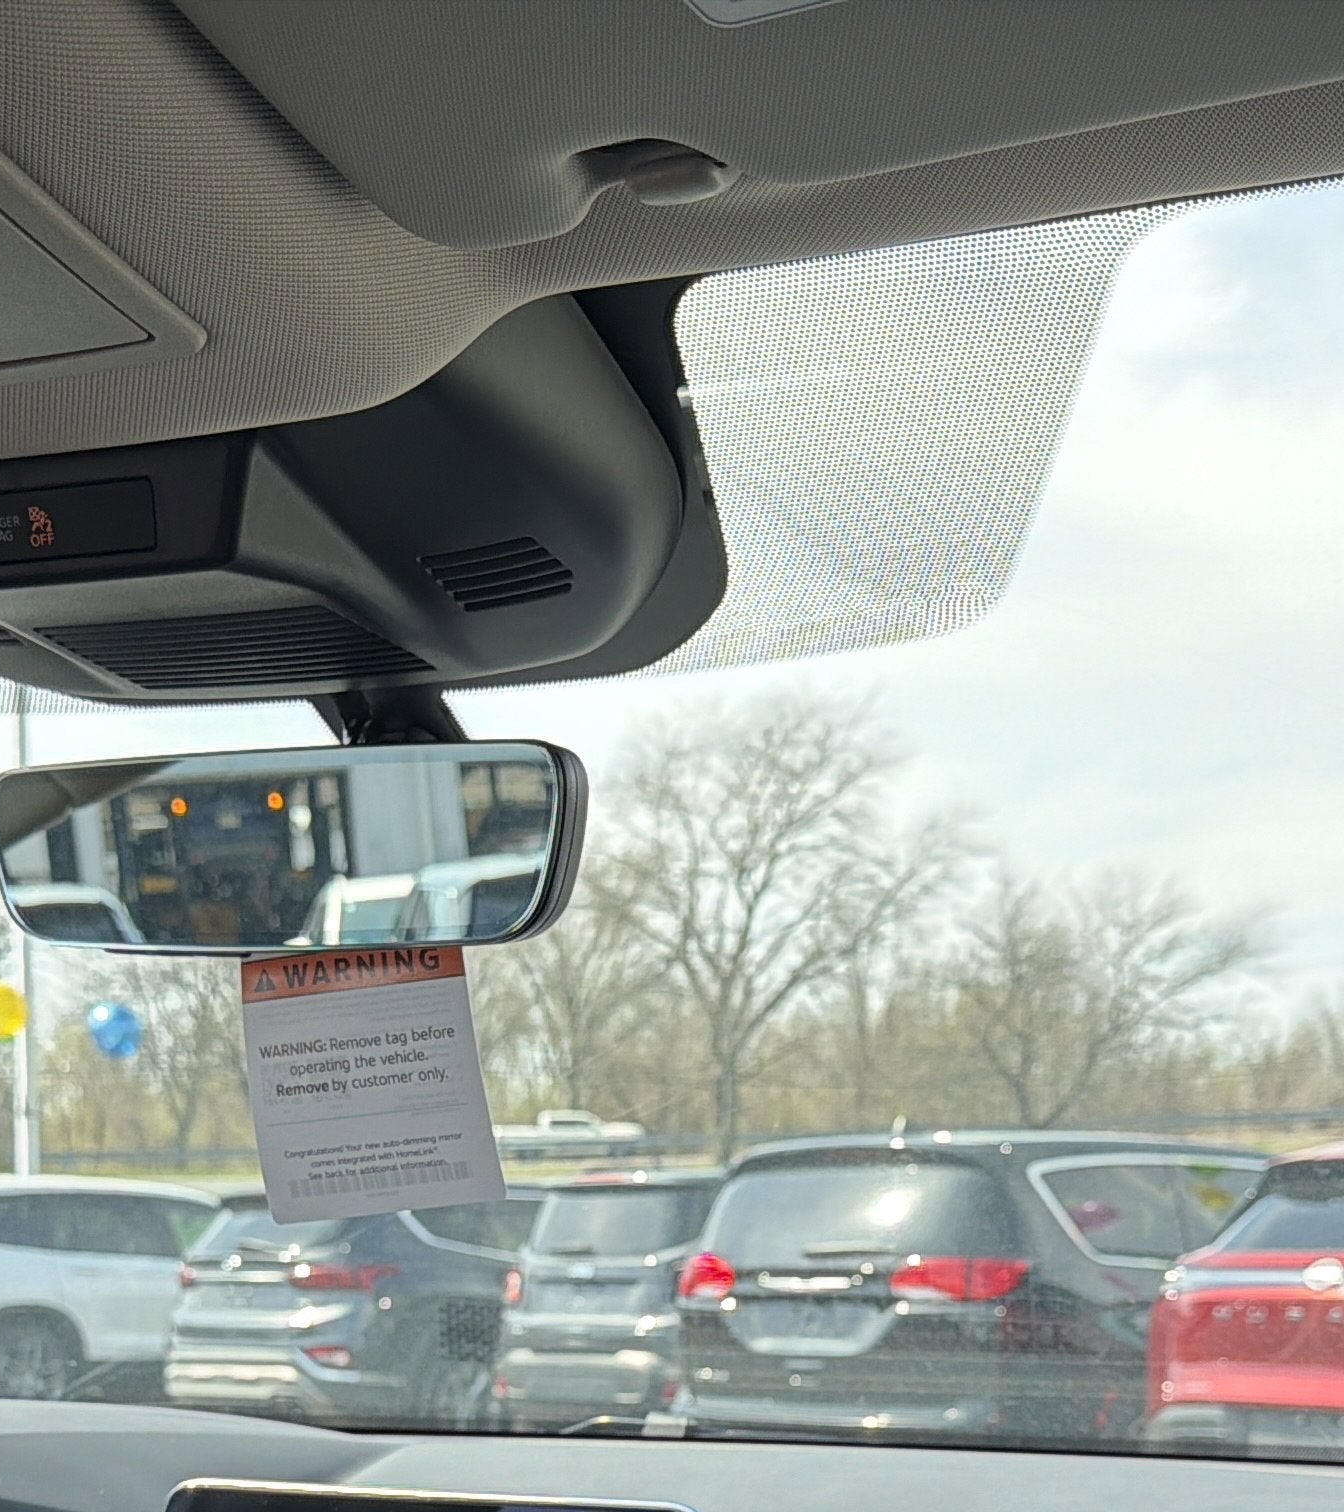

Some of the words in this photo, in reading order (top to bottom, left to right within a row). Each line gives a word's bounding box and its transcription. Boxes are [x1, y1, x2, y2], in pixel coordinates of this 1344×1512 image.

[30, 533, 55, 547] OFF
[283, 949, 440, 989] WARNING
[259, 1039, 327, 1059] WARNING:
[330, 1034, 381, 1051] Remove
[386, 1031, 407, 1045] tag
[412, 1026, 455, 1042] before
[290, 1058, 350, 1077] operating
[355, 1055, 376, 1068] the
[380, 1049, 428, 1065] vehicle.
[276, 1082, 329, 1097] Remove
[332, 1079, 347, 1093] by
[352, 1072, 413, 1090] customer
[418, 1067, 448, 1083] only.
[365, 1142, 380, 1150] new
[383, 1135, 436, 1149] auto-dimming
[438, 1133, 462, 1141] mirror
[337, 1154, 376, 1166] integrated
[346, 1168, 356, 1177] for
[360, 1164, 398, 1175] additional
